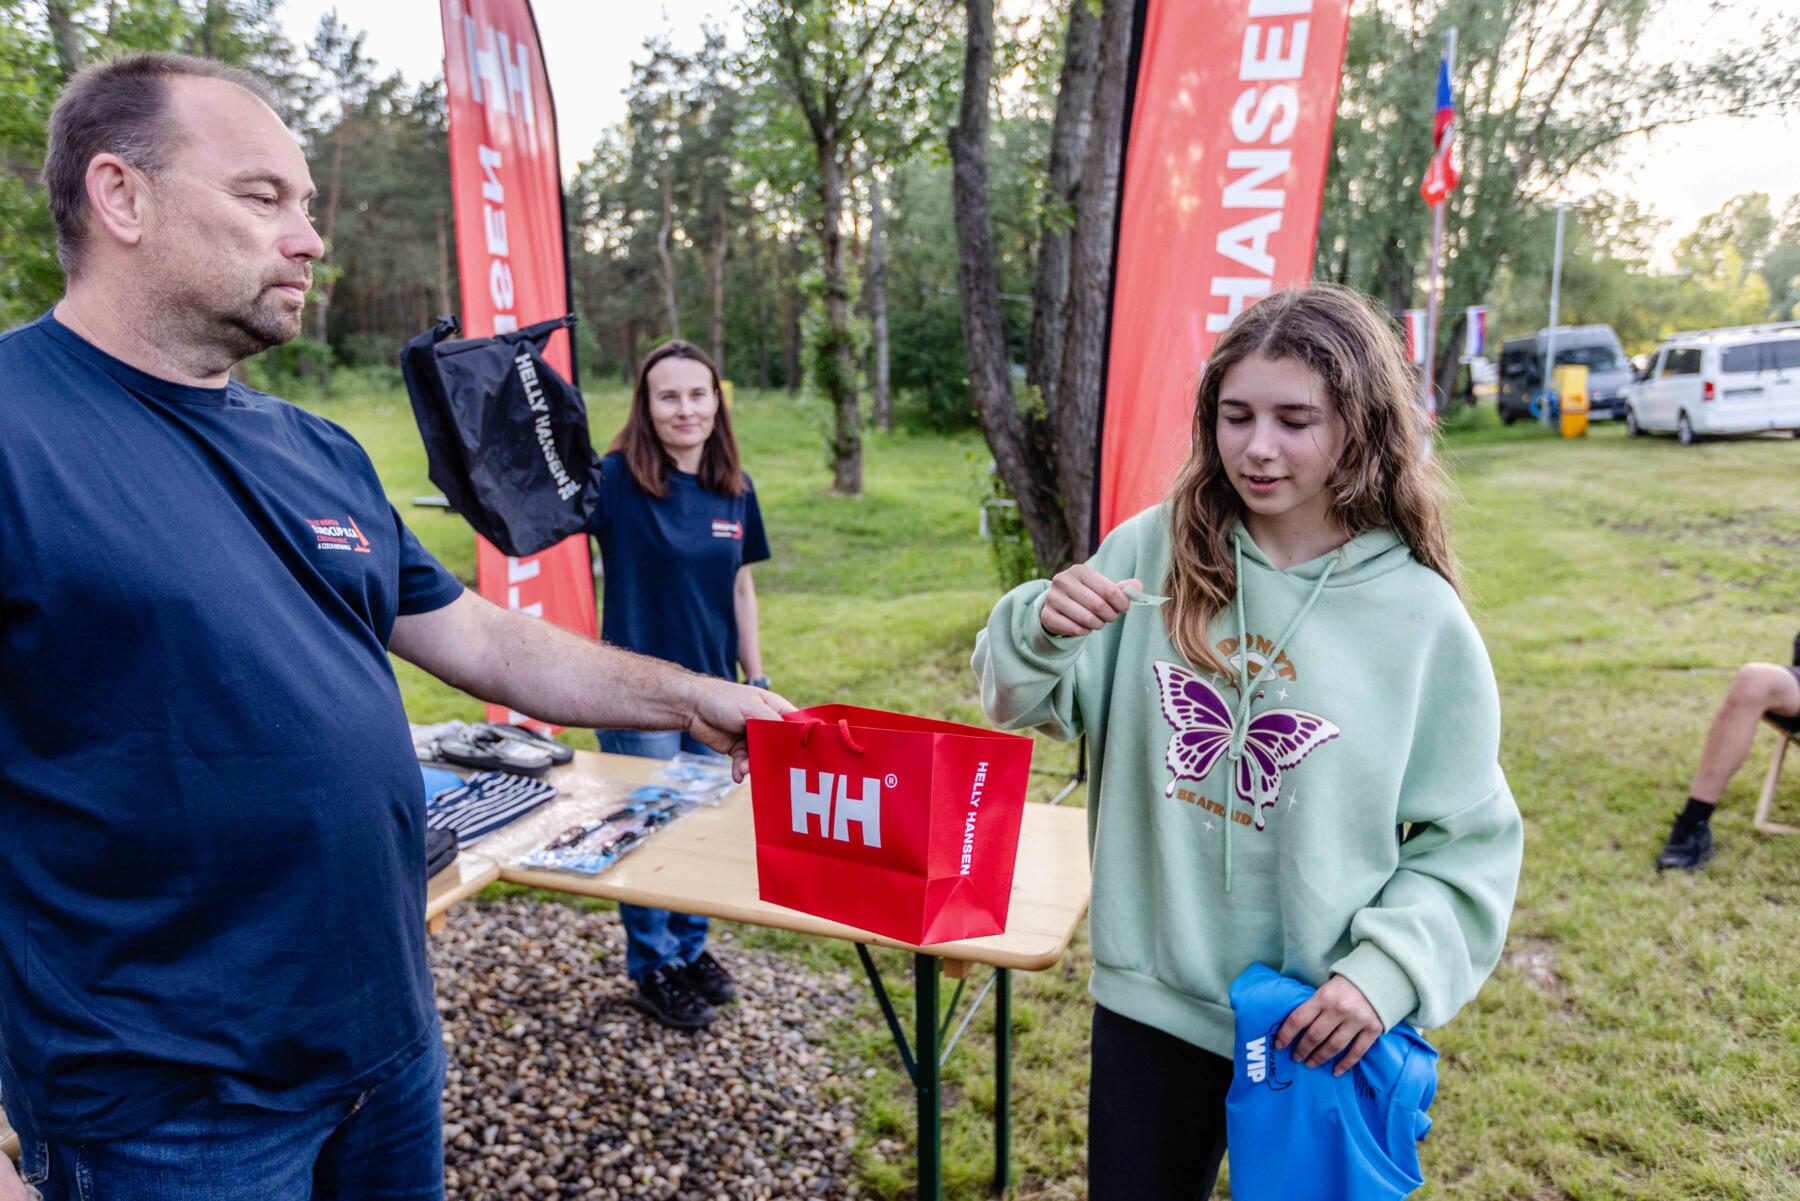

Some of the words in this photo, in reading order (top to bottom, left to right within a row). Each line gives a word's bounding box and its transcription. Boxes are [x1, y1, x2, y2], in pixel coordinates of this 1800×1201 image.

[515, 352, 549, 412] HELLY
[535, 414, 571, 487] HANSEN
[970, 761, 989, 808] HELLY
[1177, 788, 1196, 804] BE
[1196, 796, 1253, 826] AFRID
[959, 811, 977, 876] HANSEN
[1246, 1036, 1266, 1083] WIP
